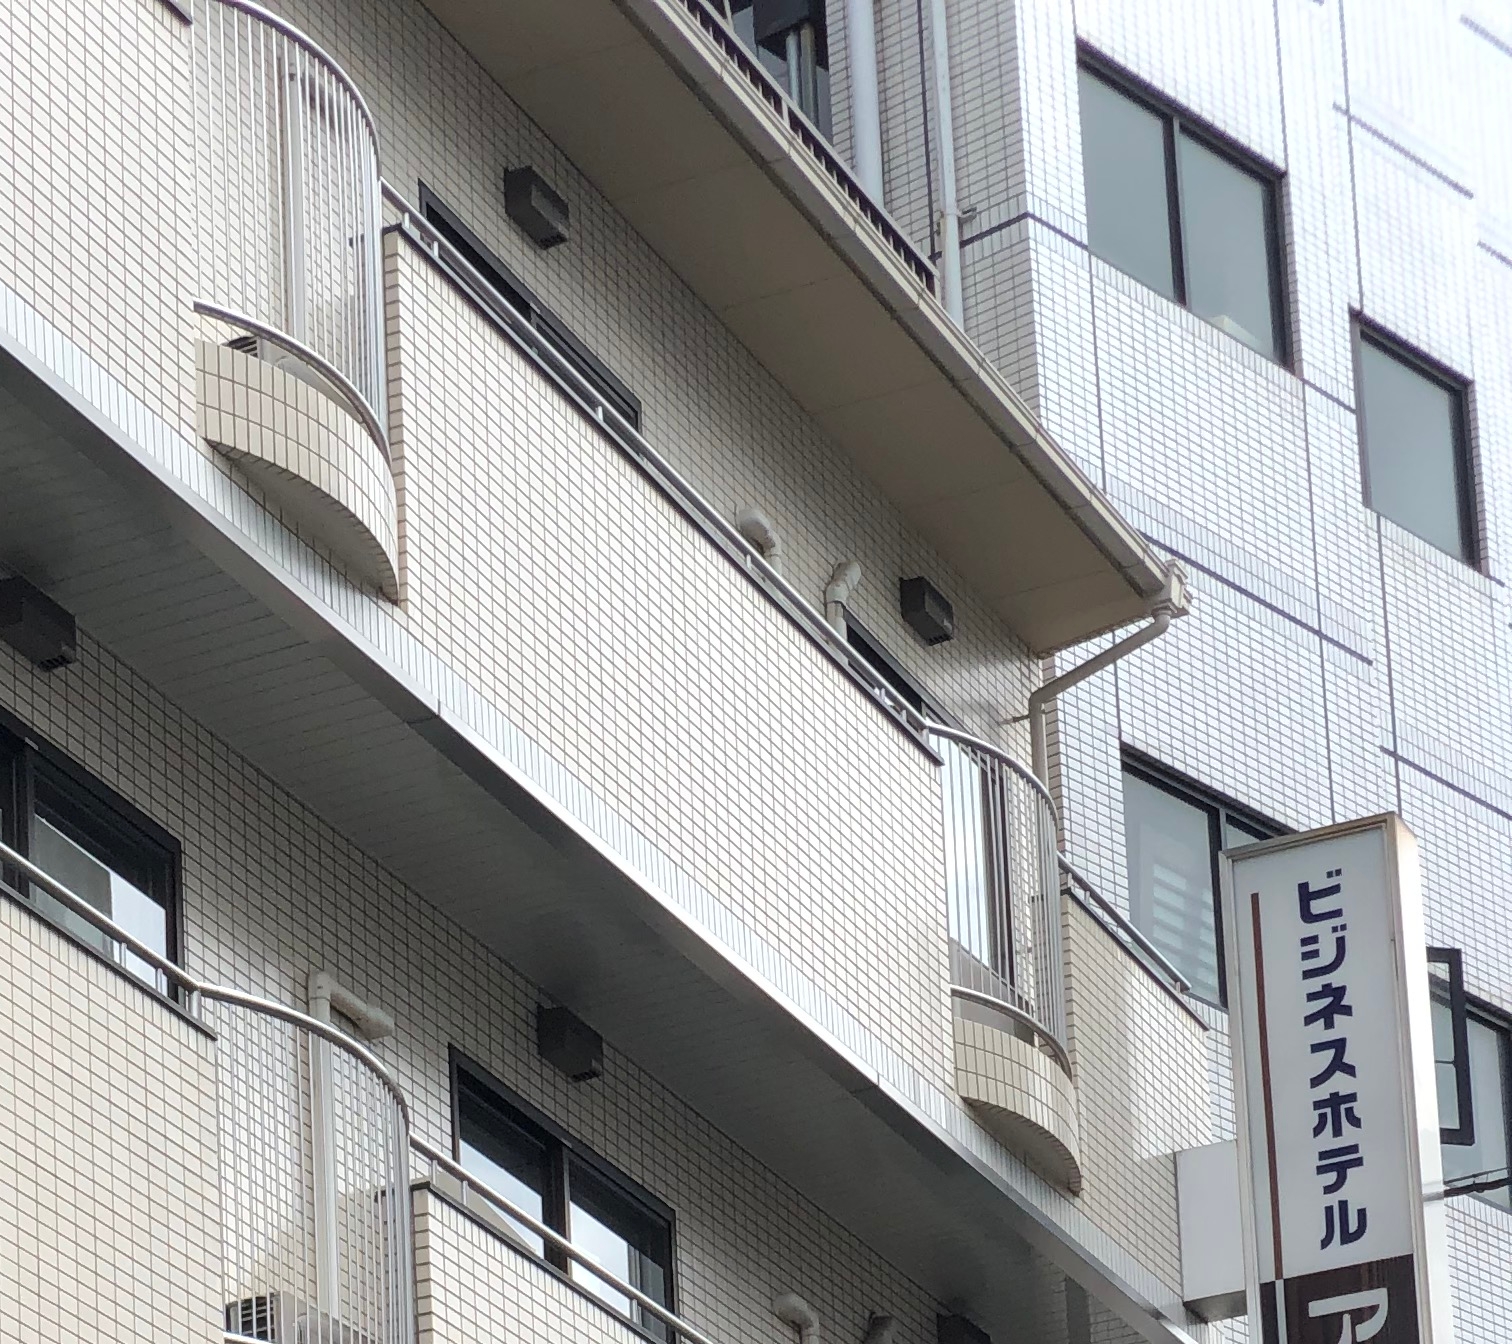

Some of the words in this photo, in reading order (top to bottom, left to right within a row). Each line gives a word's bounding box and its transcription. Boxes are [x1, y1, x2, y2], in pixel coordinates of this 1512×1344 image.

[1297, 868, 1368, 1251] ビジネスホテル
